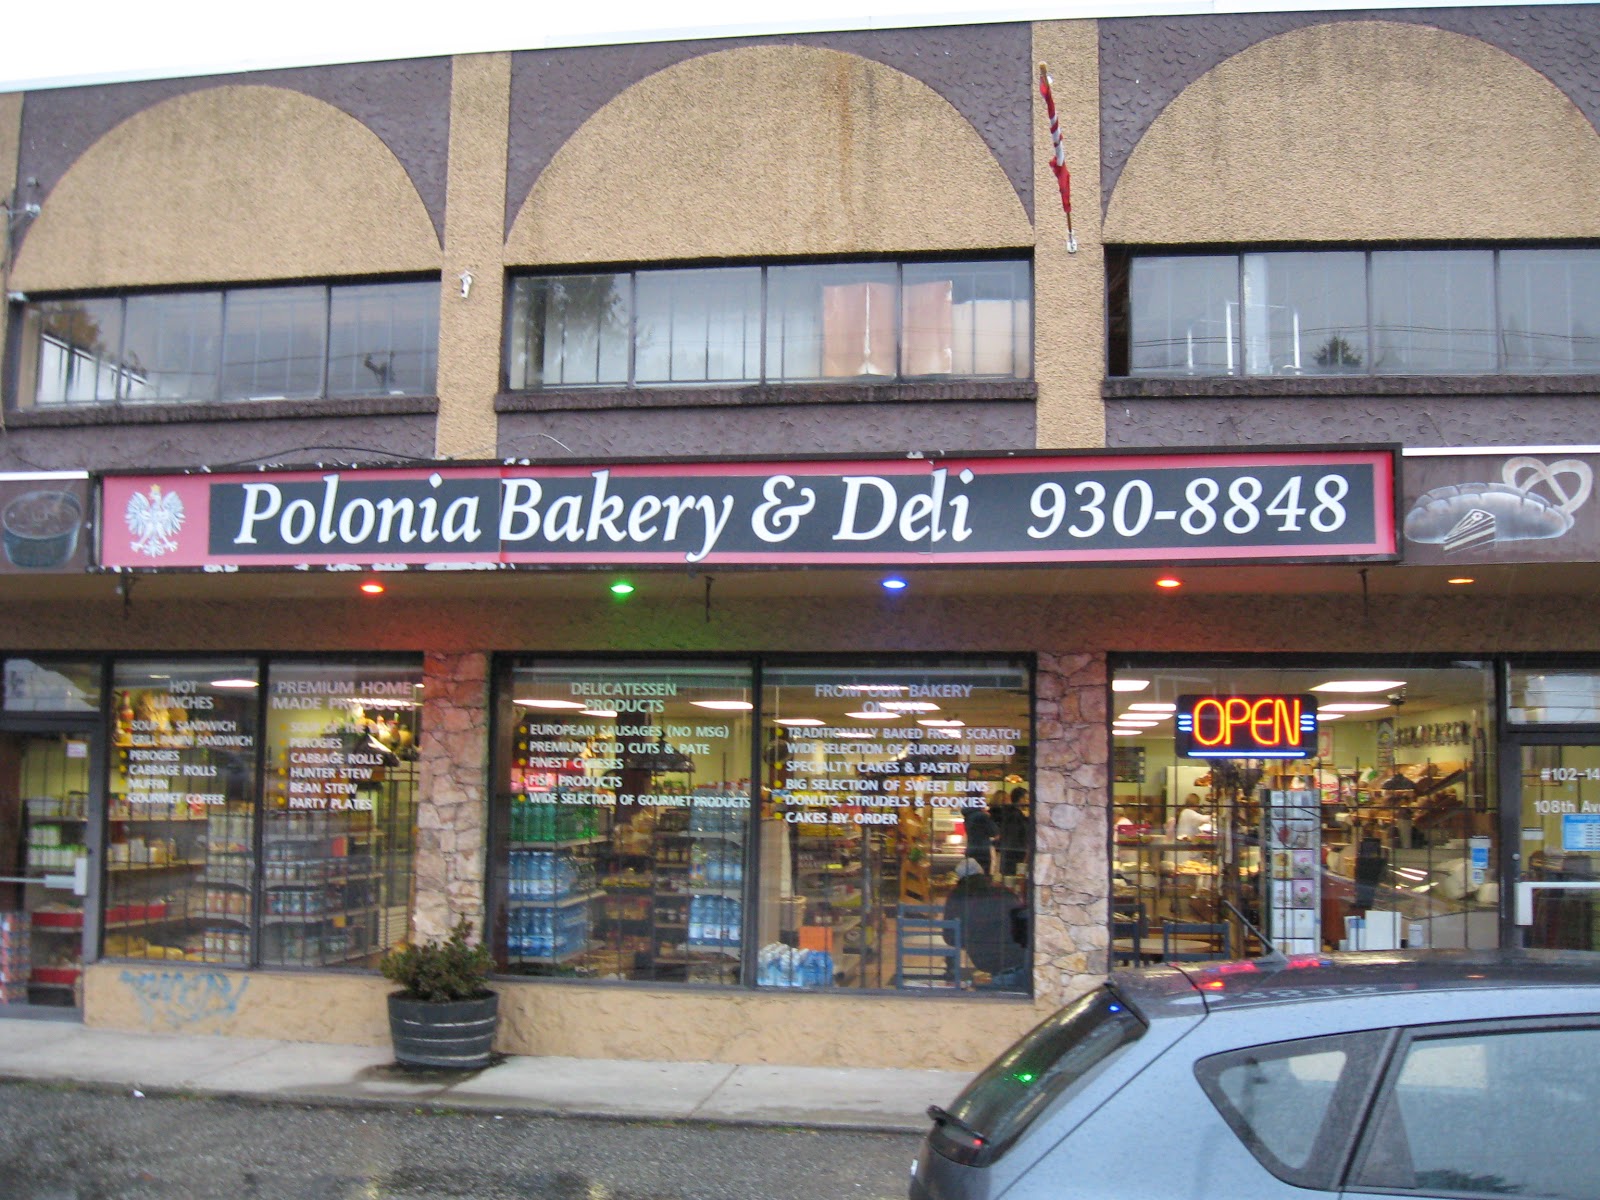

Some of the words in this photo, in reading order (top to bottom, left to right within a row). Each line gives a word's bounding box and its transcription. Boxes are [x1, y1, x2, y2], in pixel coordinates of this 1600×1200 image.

[234, 474, 481, 545] Polonia
[499, 470, 734, 563] Bakery
[751, 475, 816, 543] &
[832, 466, 976, 542] Deli
[1027, 474, 1349, 539] 930-8848
[169, 680, 198, 693] HOT
[277, 681, 355, 694] PREMIUM
[361, 681, 412, 695] HOME
[571, 682, 677, 696] DELICATESSEN
[814, 684, 860, 698] FROM
[909, 684, 973, 698] BAKERY
[153, 696, 214, 710] LUNCHES
[271, 697, 322, 710] MADE
[328, 697, 417, 711] PRDUCTS
[585, 698, 665, 713] PRODUCTS
[131, 720, 159, 731] SOUP
[175, 720, 237, 732] SANDWICH
[1193, 698, 1301, 746] OPEN
[529, 724, 595, 736] EUROPEAN
[599, 725, 663, 737] SAUSAGES
[666, 725, 692, 738] (NO
[695, 725, 729, 739] MSG)
[787, 727, 879, 739] TRADITIONALLY
[882, 728, 923, 739] BAKED
[966, 728, 1022, 740] SCRATCH
[195, 735, 253, 747] SANDWICH
[289, 737, 343, 749] PEROGIES
[529, 740, 588, 752] PREMIUM
[591, 741, 625, 753] COLD
[628, 742, 660, 754] CUTS
[664, 742, 675, 754] &
[679, 743, 710, 755] PATE
[129, 750, 180, 761] PEROGIES
[786, 742, 821, 754] WIDE
[823, 743, 883, 755] SELECTION
[886, 743, 904, 755] OF
[908, 743, 972, 755] EUROPEAN
[975, 744, 1016, 756] BREAD
[290, 752, 345, 765] CABBAGE
[348, 753, 384, 765] ROLLS
[528, 756, 570, 768] FINEST
[128, 764, 181, 776] CABBAGE
[183, 765, 218, 777] ROLLS
[289, 767, 337, 778] HUNTER
[340, 767, 373, 779] STEW
[786, 760, 851, 773] SPECIALTY
[857, 761, 900, 773] CAKES
[904, 761, 916, 773] &
[919, 761, 971, 774] PASTRY
[128, 778, 169, 789] MUFFIN
[289, 781, 322, 793] BEAN
[325, 782, 358, 794] STEW
[528, 775, 552, 787] FISH
[557, 775, 623, 788] PRODUCTS
[785, 778, 807, 790] BIG
[811, 779, 879, 791] SELECTION
[882, 780, 900, 791] OF
[904, 780, 950, 792] SWEET
[954, 780, 990, 792] BUNS
[126, 792, 182, 804] GOURMET
[185, 793, 226, 805] COFFEE
[289, 797, 328, 809] PARTY
[330, 798, 373, 810] PLATES
[529, 792, 558, 804] WIDE
[560, 793, 616, 805] SELECTION
[619, 793, 635, 806] OF
[637, 794, 693, 807] GOURMET
[693, 795, 751, 808] PRODUCTS
[785, 795, 842, 808] DONUTS,
[846, 795, 910, 807] STRUDELS
[914, 795, 926, 807] &
[930, 796, 987, 808] COOKIES
[1534, 800, 1576, 813] 108th
[785, 812, 828, 824] CAKES
[831, 812, 849, 824] BY
[853, 812, 899, 825] ORDER
